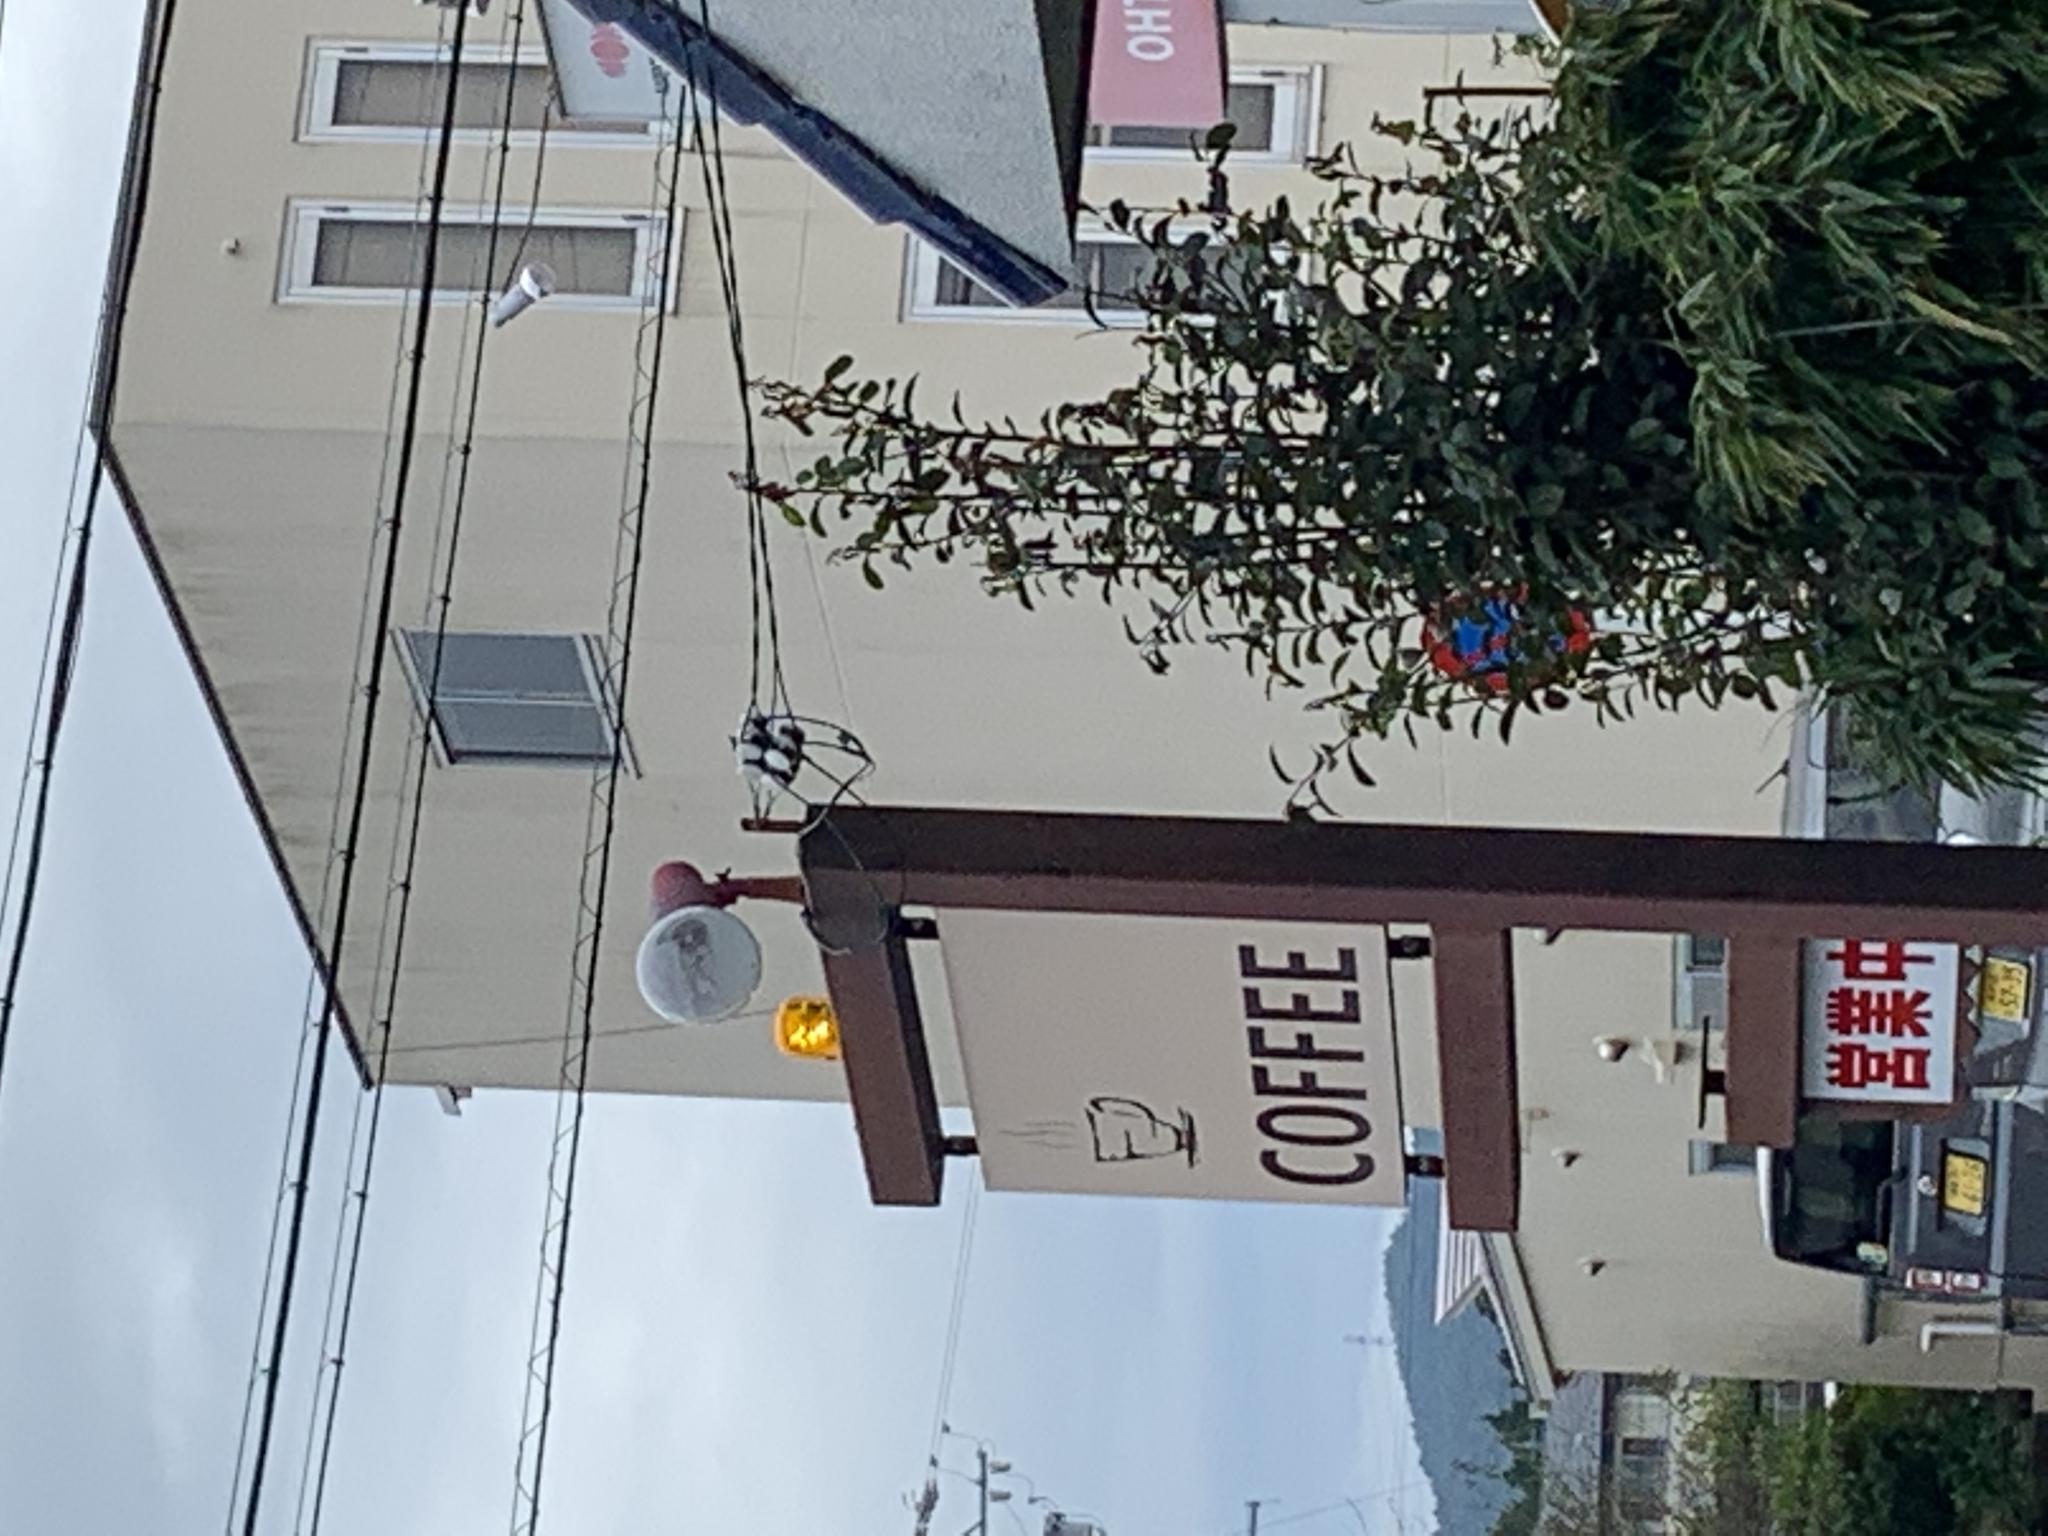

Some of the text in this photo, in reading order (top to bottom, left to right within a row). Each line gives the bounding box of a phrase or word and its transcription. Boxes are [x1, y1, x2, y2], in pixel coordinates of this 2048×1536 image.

[1238, 944, 1375, 1185] COFFEE
[1826, 938, 1935, 1090] 営業中
